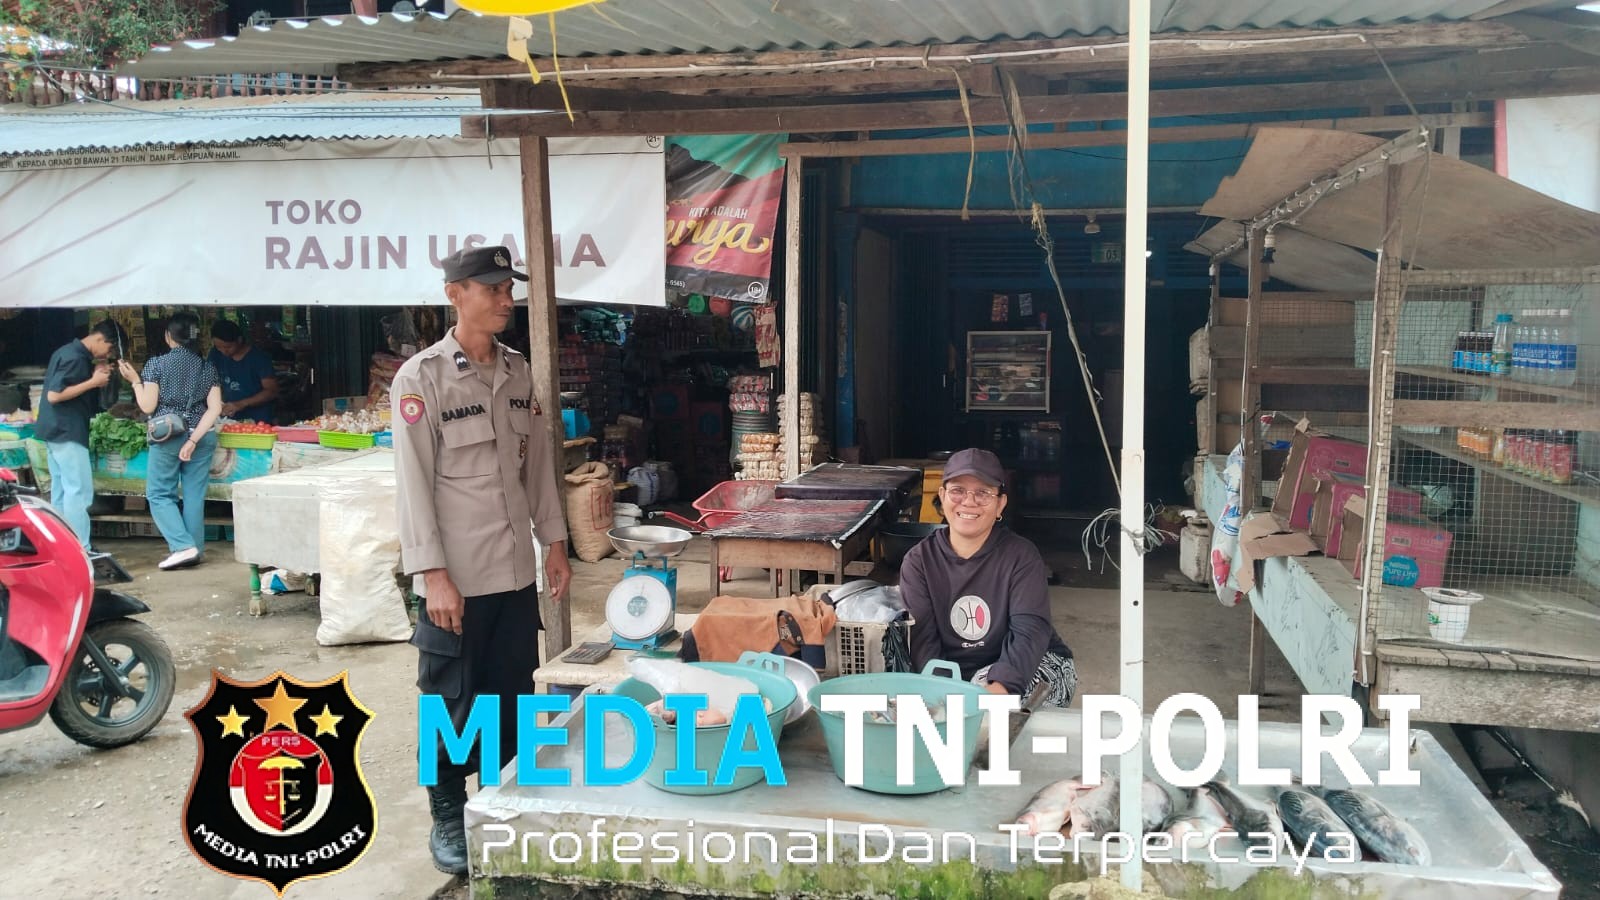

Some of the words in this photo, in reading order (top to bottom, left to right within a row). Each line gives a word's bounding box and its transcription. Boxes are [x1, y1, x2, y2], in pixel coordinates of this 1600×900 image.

[17, 158, 47, 168] KEPADA
[48, 157, 73, 167] ORANG
[74, 156, 81, 165] DI
[83, 155, 110, 165] BAWAH
[121, 154, 146, 163] TAHUN
[150, 153, 166, 162] DAN
[265, 199, 362, 225] TOKO
[688, 207, 709, 218] KITA
[710, 205, 748, 219] ADALAH
[265, 235, 408, 270] RAJIN
[441, 403, 487, 422] SAMADA
